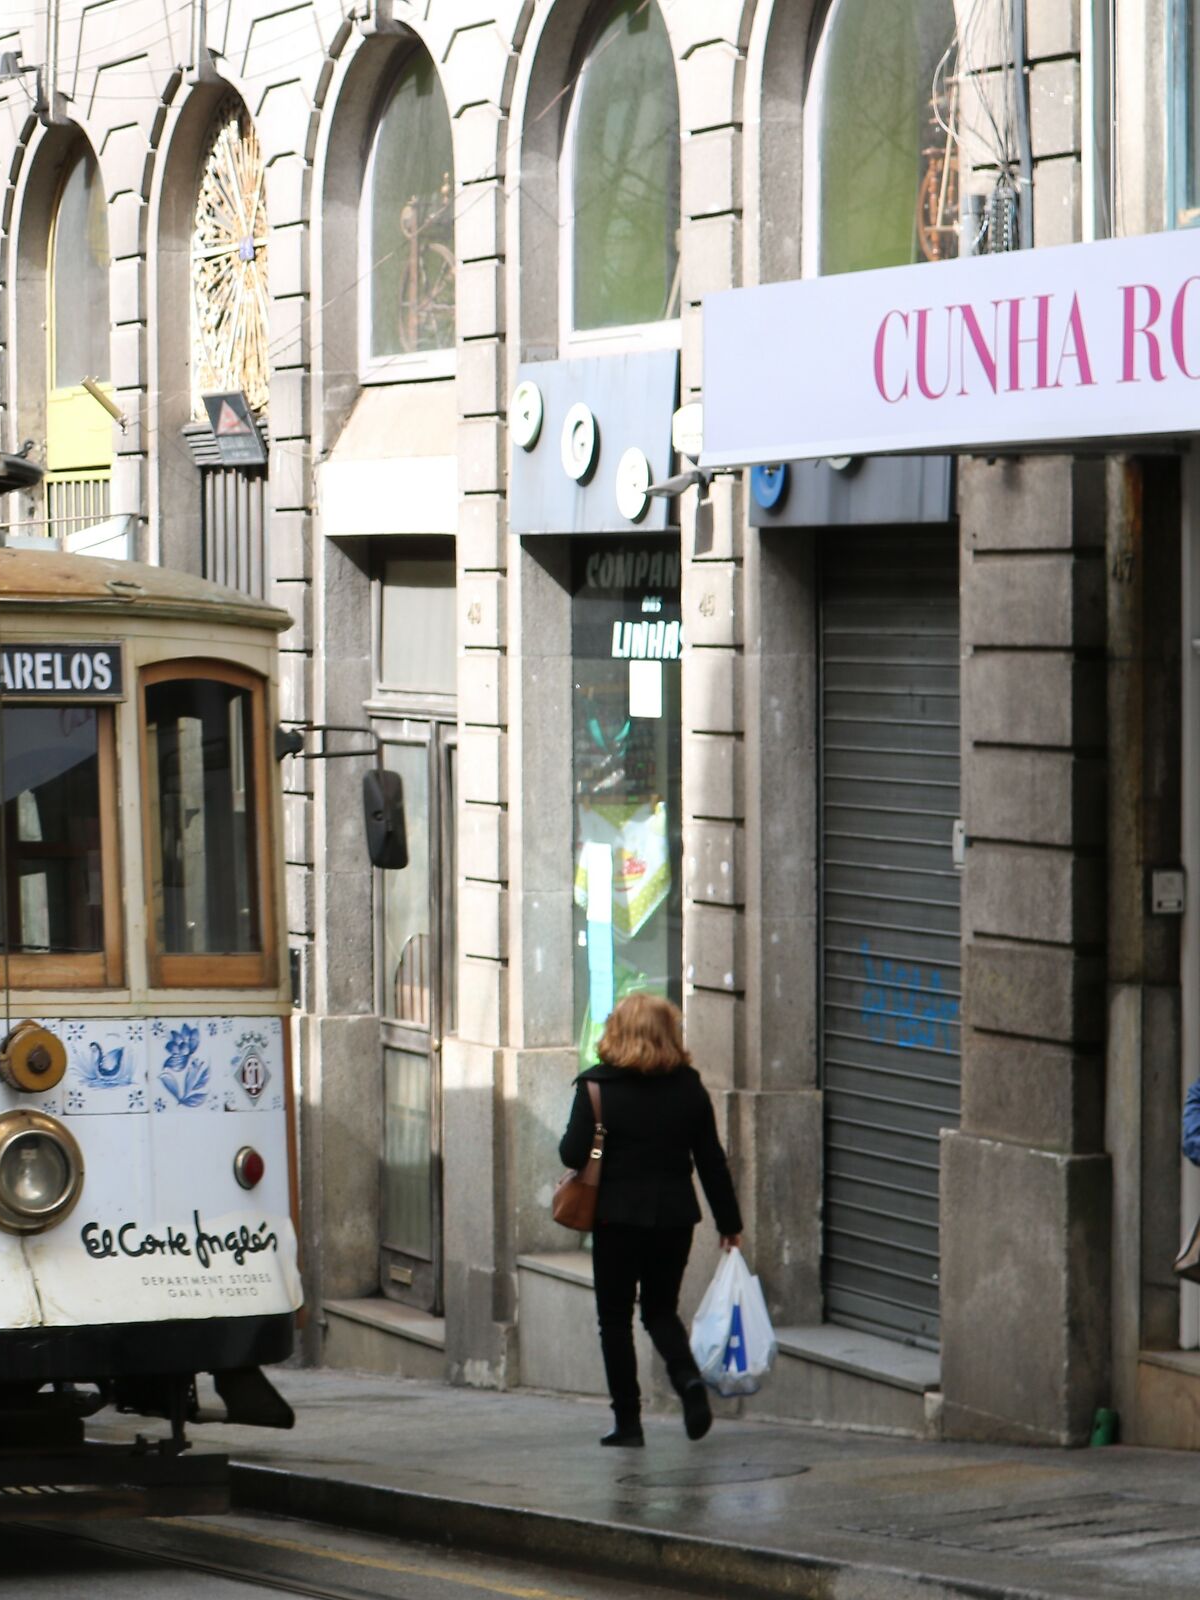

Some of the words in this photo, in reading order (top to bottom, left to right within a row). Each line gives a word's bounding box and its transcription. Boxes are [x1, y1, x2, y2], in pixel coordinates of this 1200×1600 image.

[874, 290, 1098, 403] CUNHA
[611, 620, 682, 659] LINHA
[81, 1221, 118, 1259] El
[118, 1221, 191, 1257] Corte
[141, 1274, 224, 1287] DEPARTMENT
[231, 1273, 272, 1285] STORES
[168, 1288, 201, 1298] GAIA
[218, 1286, 259, 1298] PORTO
